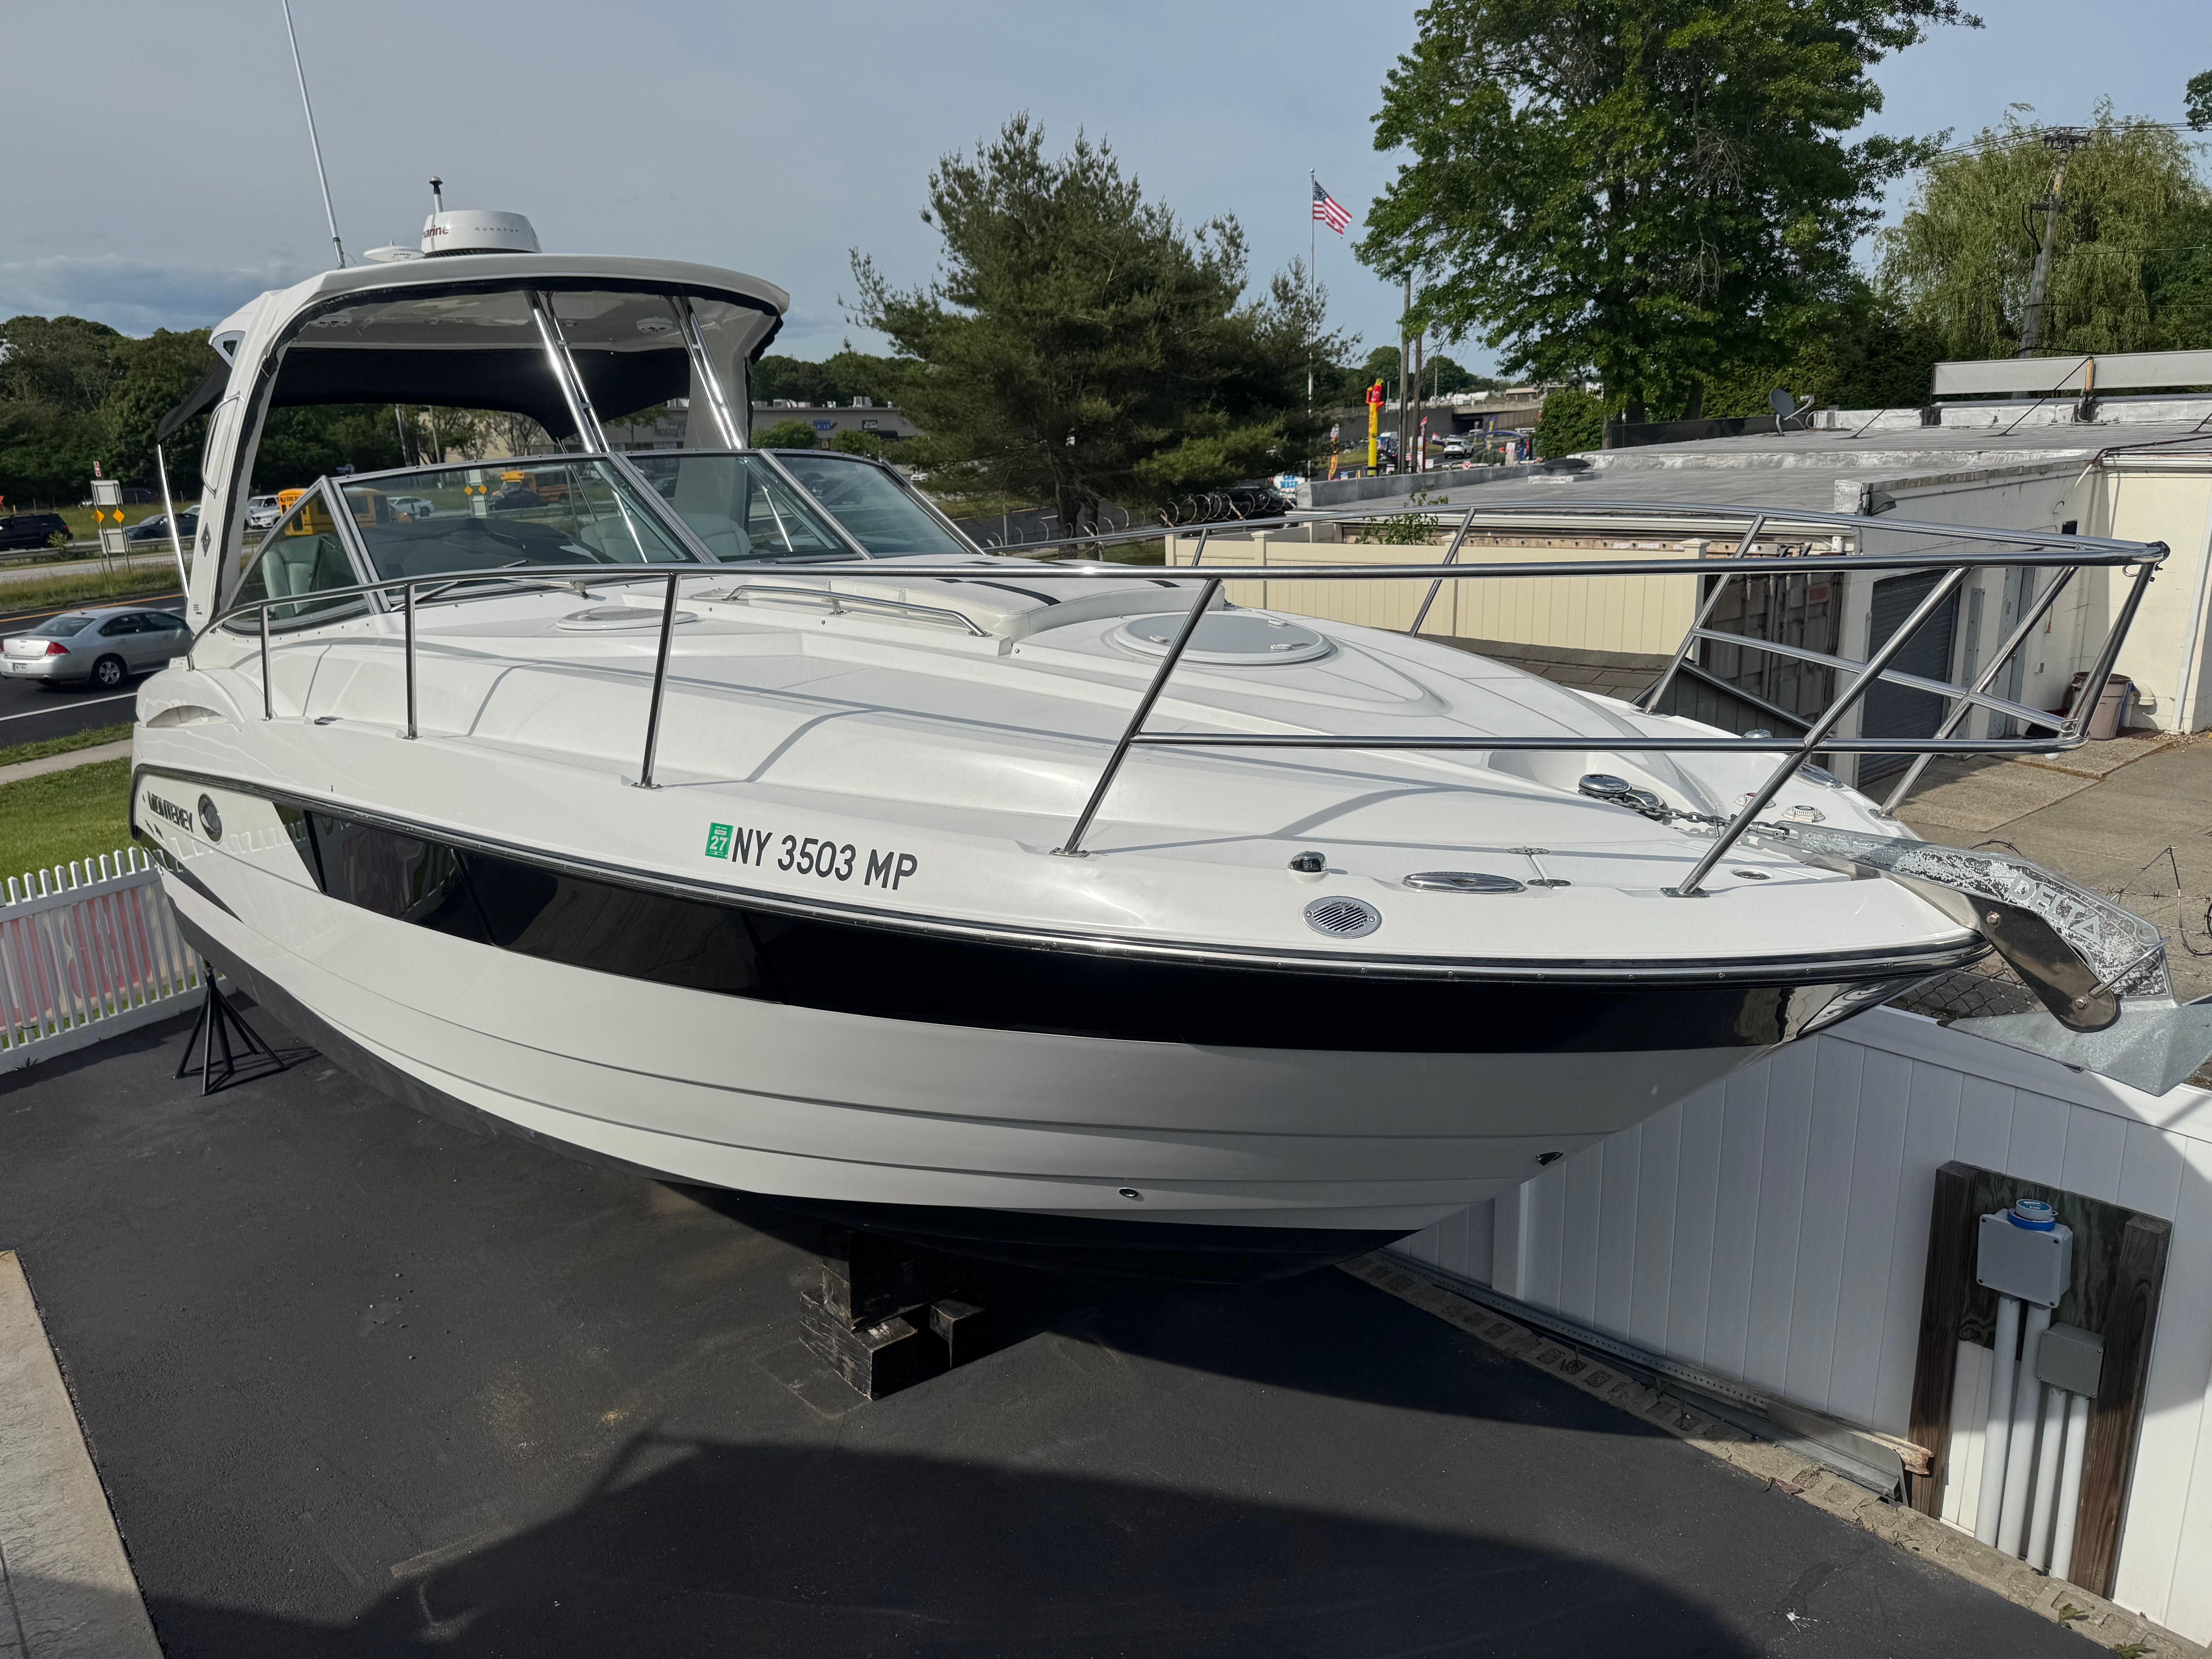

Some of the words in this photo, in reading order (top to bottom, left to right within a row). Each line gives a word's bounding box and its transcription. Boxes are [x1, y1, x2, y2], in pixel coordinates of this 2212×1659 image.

[148, 790, 194, 833] MONTEREY
[709, 835, 728, 851] 27
[732, 827, 773, 866] NY
[777, 835, 856, 881] 3503
[864, 848, 918, 890] MP
[2007, 873, 2101, 943] DELTA
